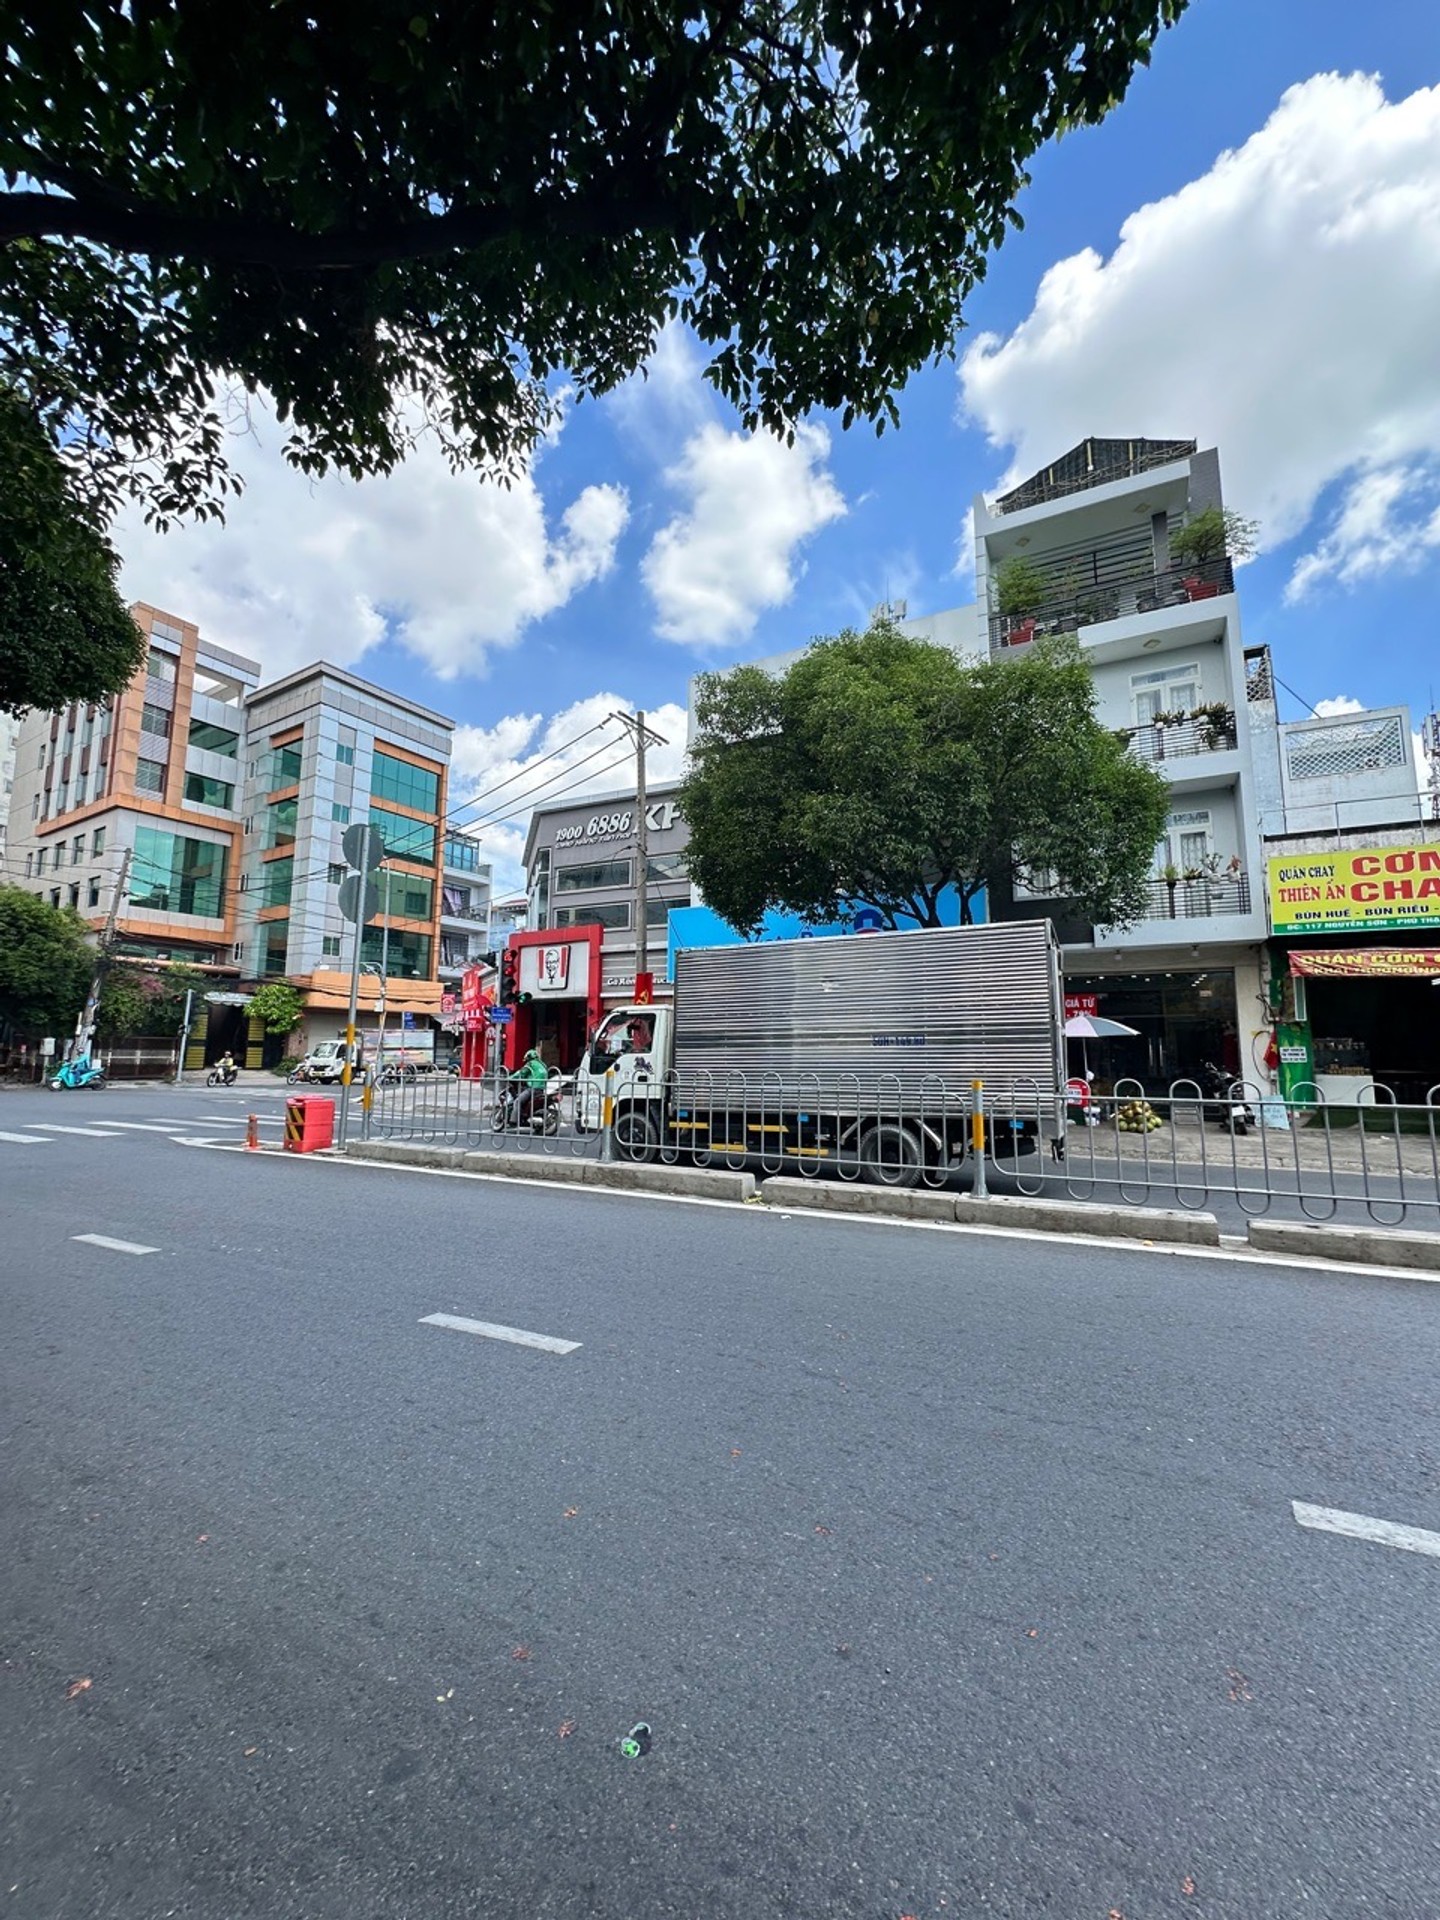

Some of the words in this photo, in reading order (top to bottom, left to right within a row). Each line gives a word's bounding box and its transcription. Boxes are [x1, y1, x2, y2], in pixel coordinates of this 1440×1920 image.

[556, 825, 583, 841] 1900
[587, 812, 632, 836] 6886
[1279, 865, 1306, 882] QUÁN
[1308, 865, 1335, 879] CHAY
[1278, 883, 1321, 903] THIÊN
[1326, 879, 1346, 900] ẤN
[1295, 911, 1321, 920] BÚN
[1365, 906, 1393, 917] BÚN
[1305, 922, 1321, 930] 117
[1366, 919, 1388, 927] SƠN
[1065, 996, 1080, 1008] GIÁ
